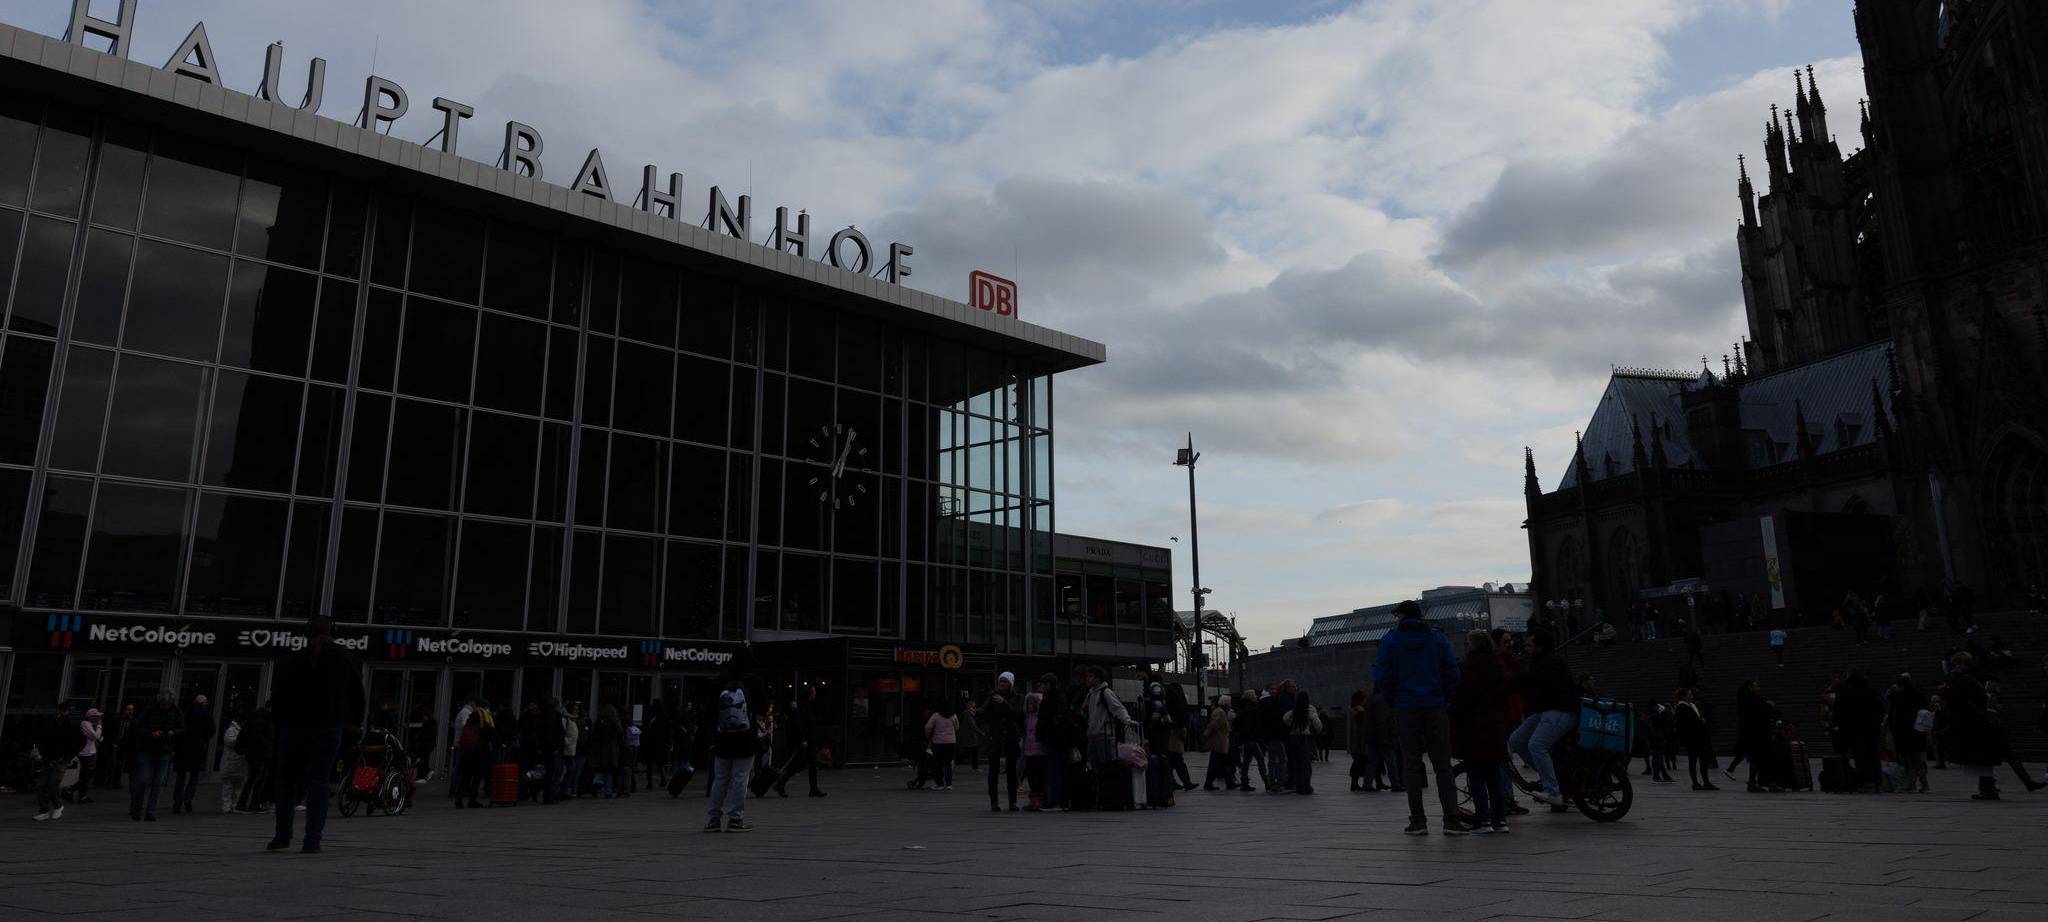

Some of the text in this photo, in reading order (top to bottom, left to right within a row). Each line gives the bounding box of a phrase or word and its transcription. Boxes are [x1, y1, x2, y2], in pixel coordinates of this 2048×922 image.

[67, 0, 914, 284] HAUPTBAHNHOF
[978, 278, 1012, 316] DB
[89, 623, 216, 648] NetCologne
[272, 631, 369, 652] Higeed
[417, 636, 512, 658] NetCologne
[554, 642, 628, 661] Highspeed
[665, 647, 733, 665] NetCologn
